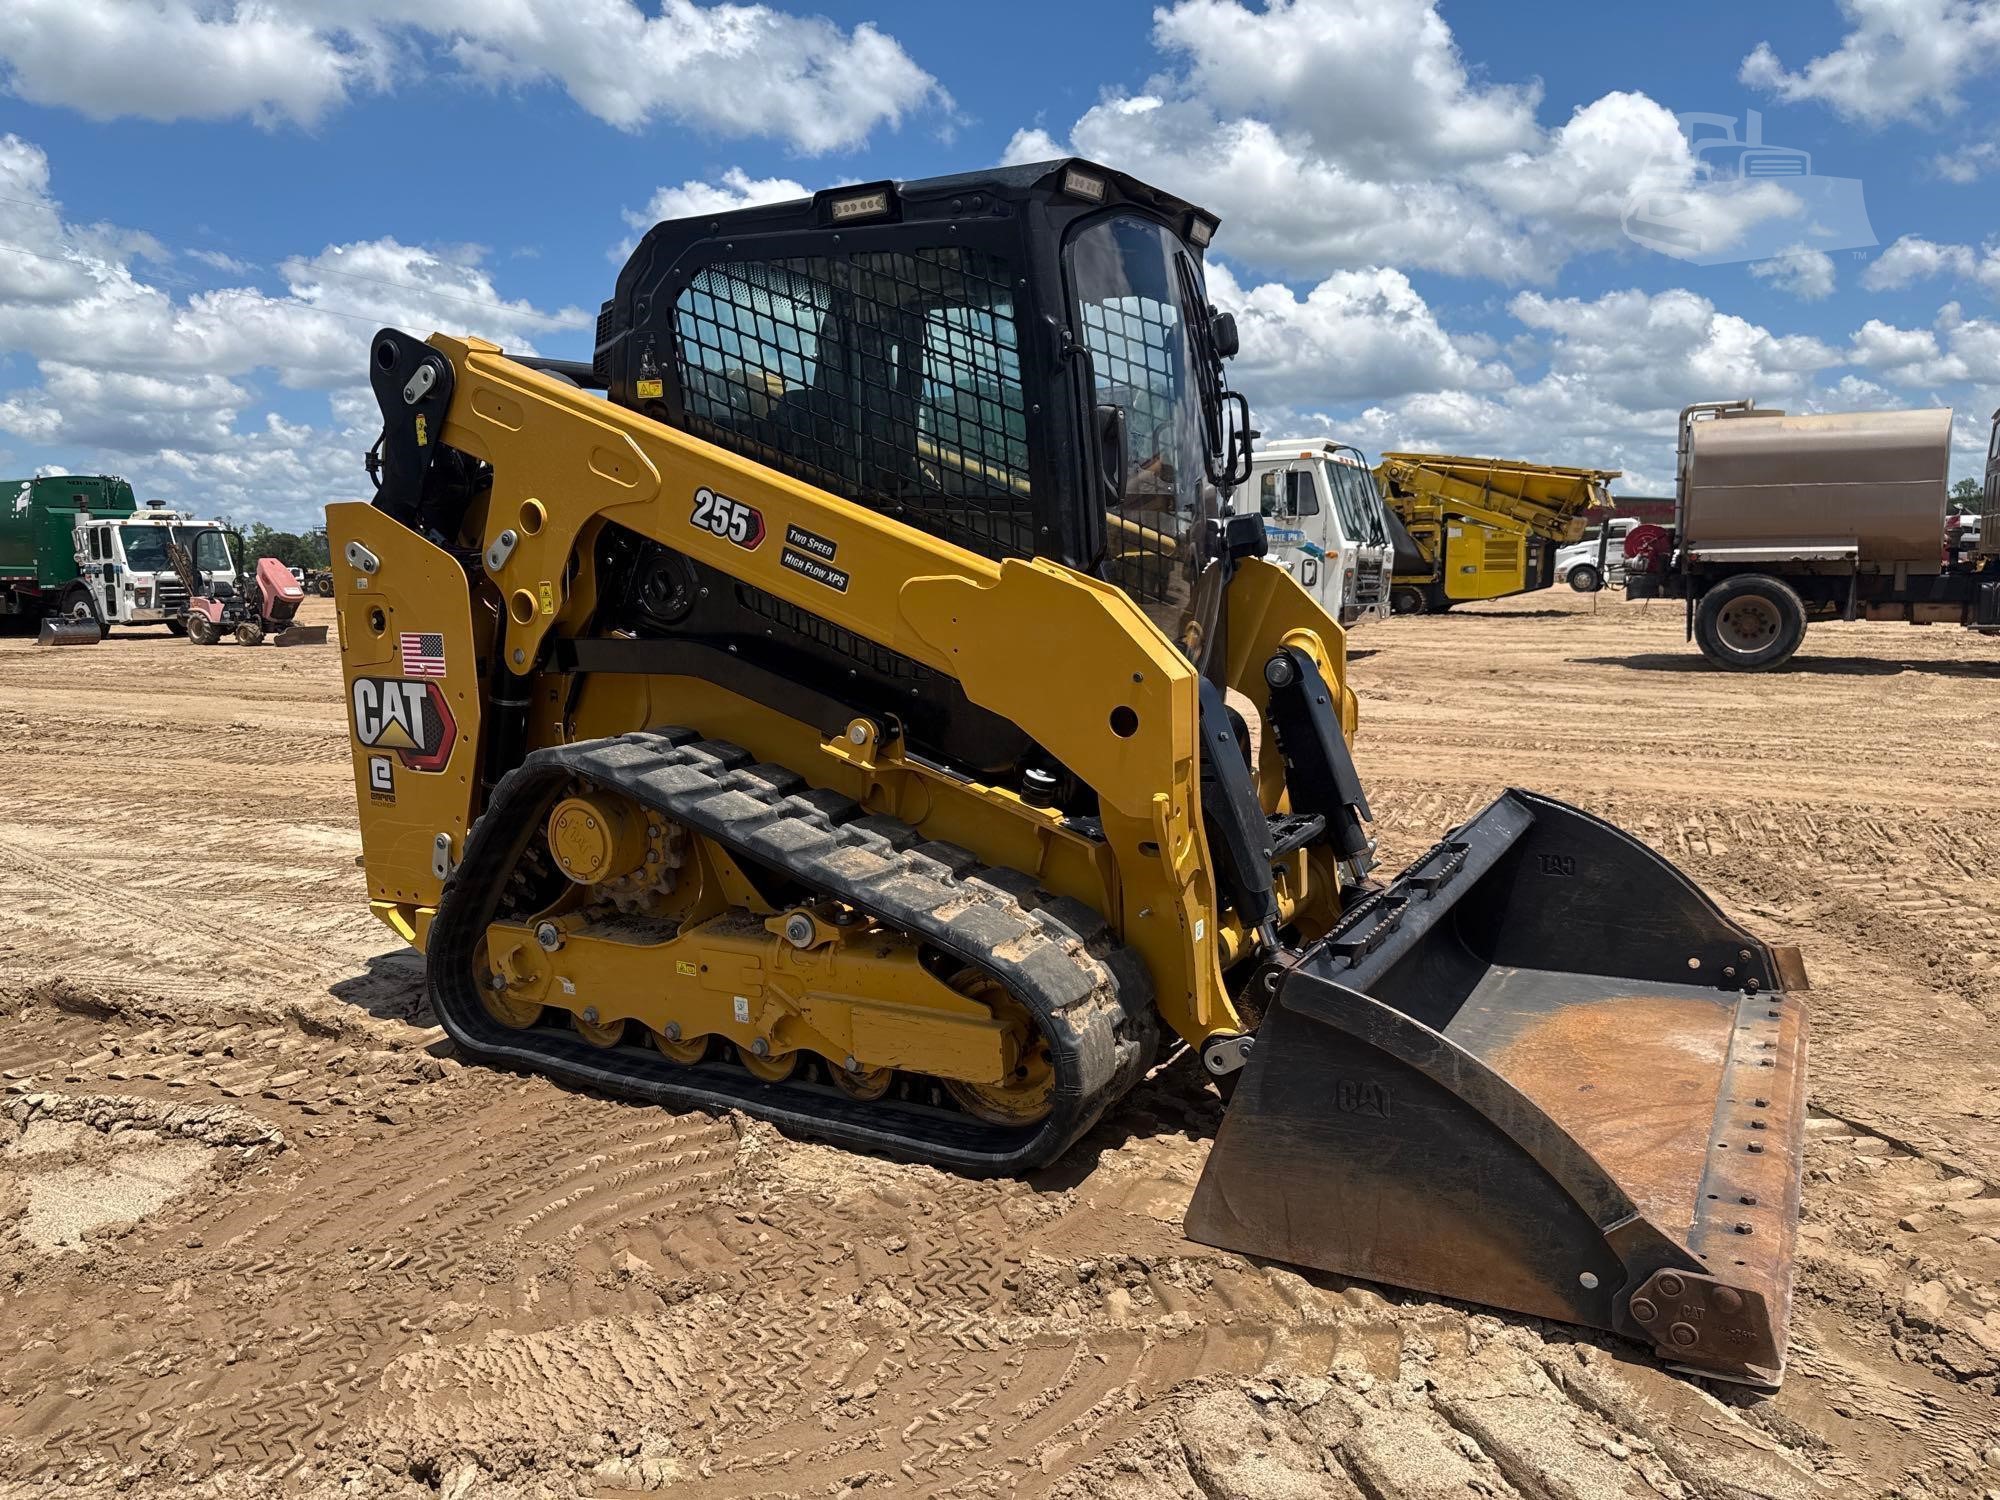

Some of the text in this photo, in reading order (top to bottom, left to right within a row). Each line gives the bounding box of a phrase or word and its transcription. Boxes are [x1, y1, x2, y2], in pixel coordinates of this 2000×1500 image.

[692, 489, 750, 542] 255
[789, 529, 833, 556] TWO SPEED
[784, 553, 846, 587] HIGH FLOW XPS
[353, 678, 428, 750] CAT
[1336, 1080, 1392, 1119] CAT
[1682, 1304, 1705, 1320] CAT
